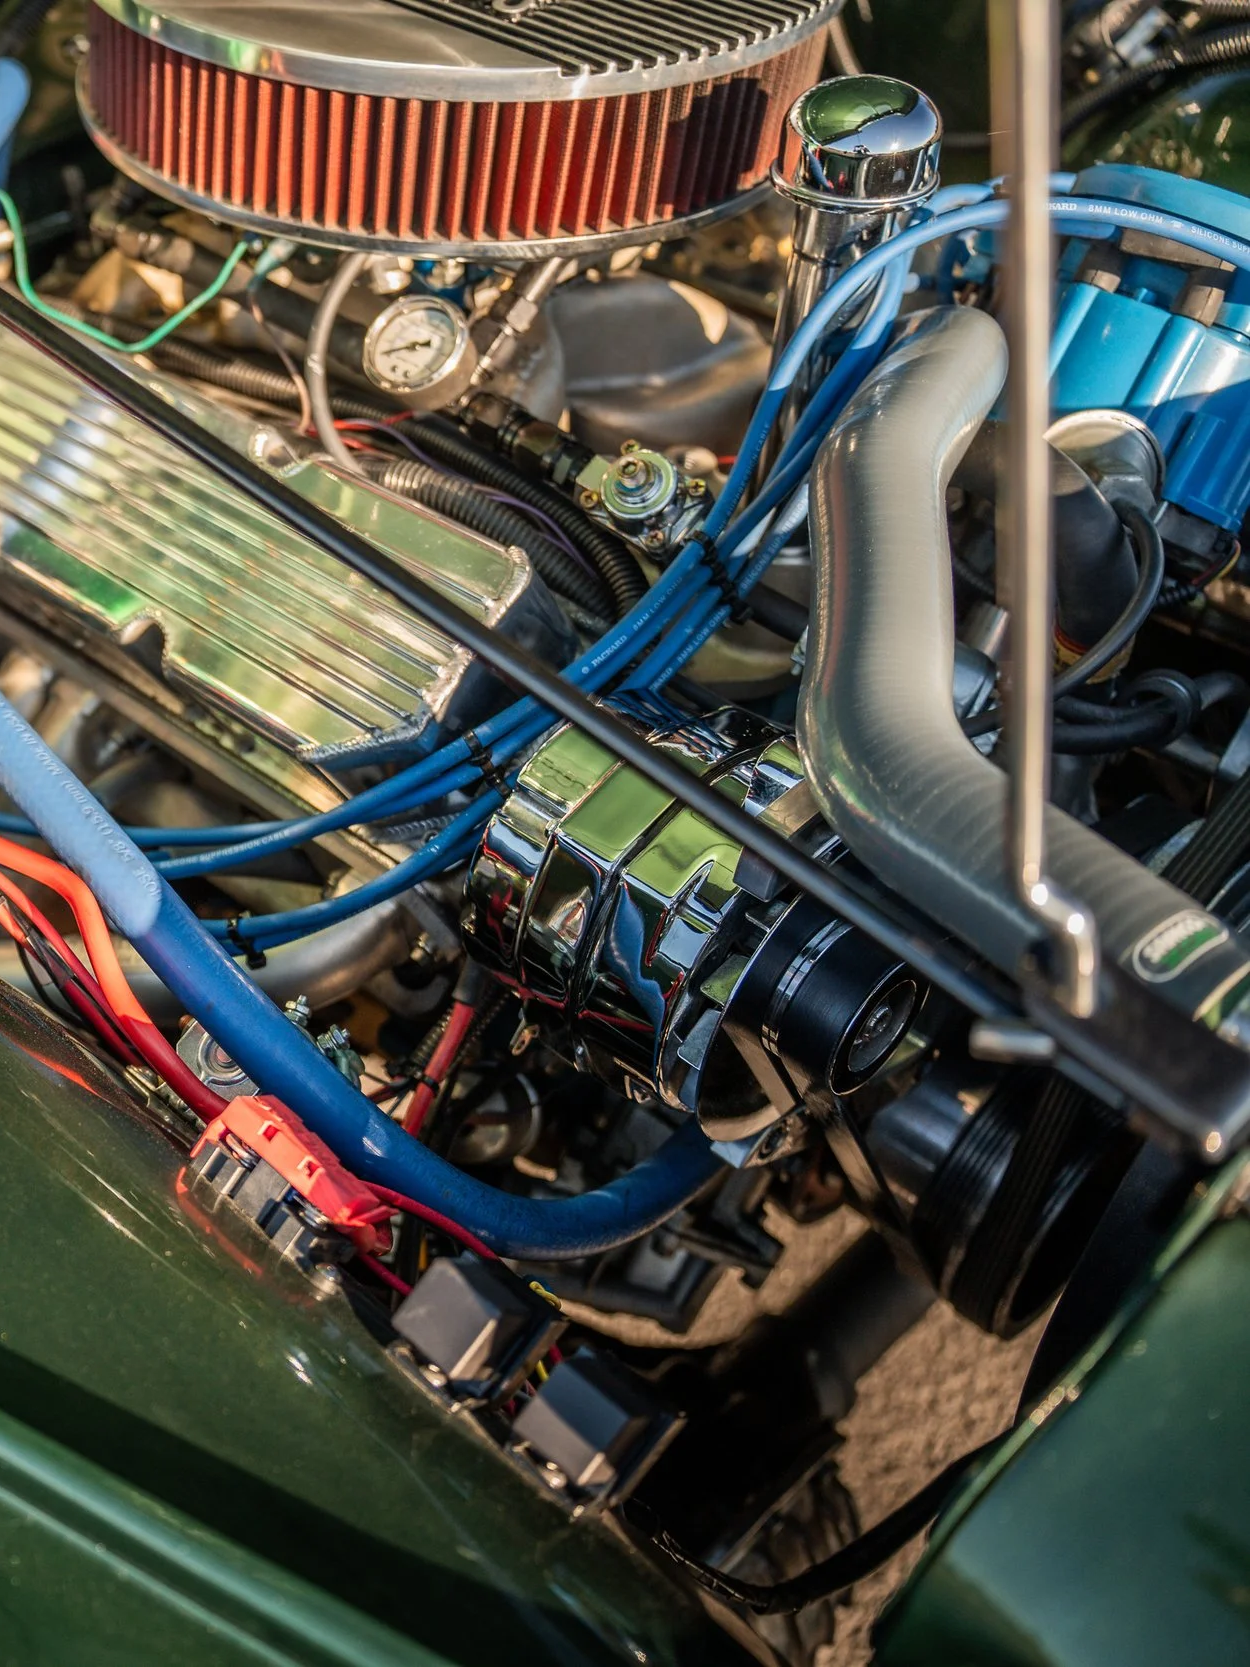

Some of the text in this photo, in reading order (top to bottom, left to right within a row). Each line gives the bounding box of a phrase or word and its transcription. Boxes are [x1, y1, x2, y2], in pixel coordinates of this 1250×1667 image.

[1088, 204, 1111, 214] 8MM
[1114, 207, 1139, 220] LOW
[1140, 211, 1164, 224] OHM
[1190, 225, 1230, 246] SILICONE
[590, 634, 628, 667] PACKARD
